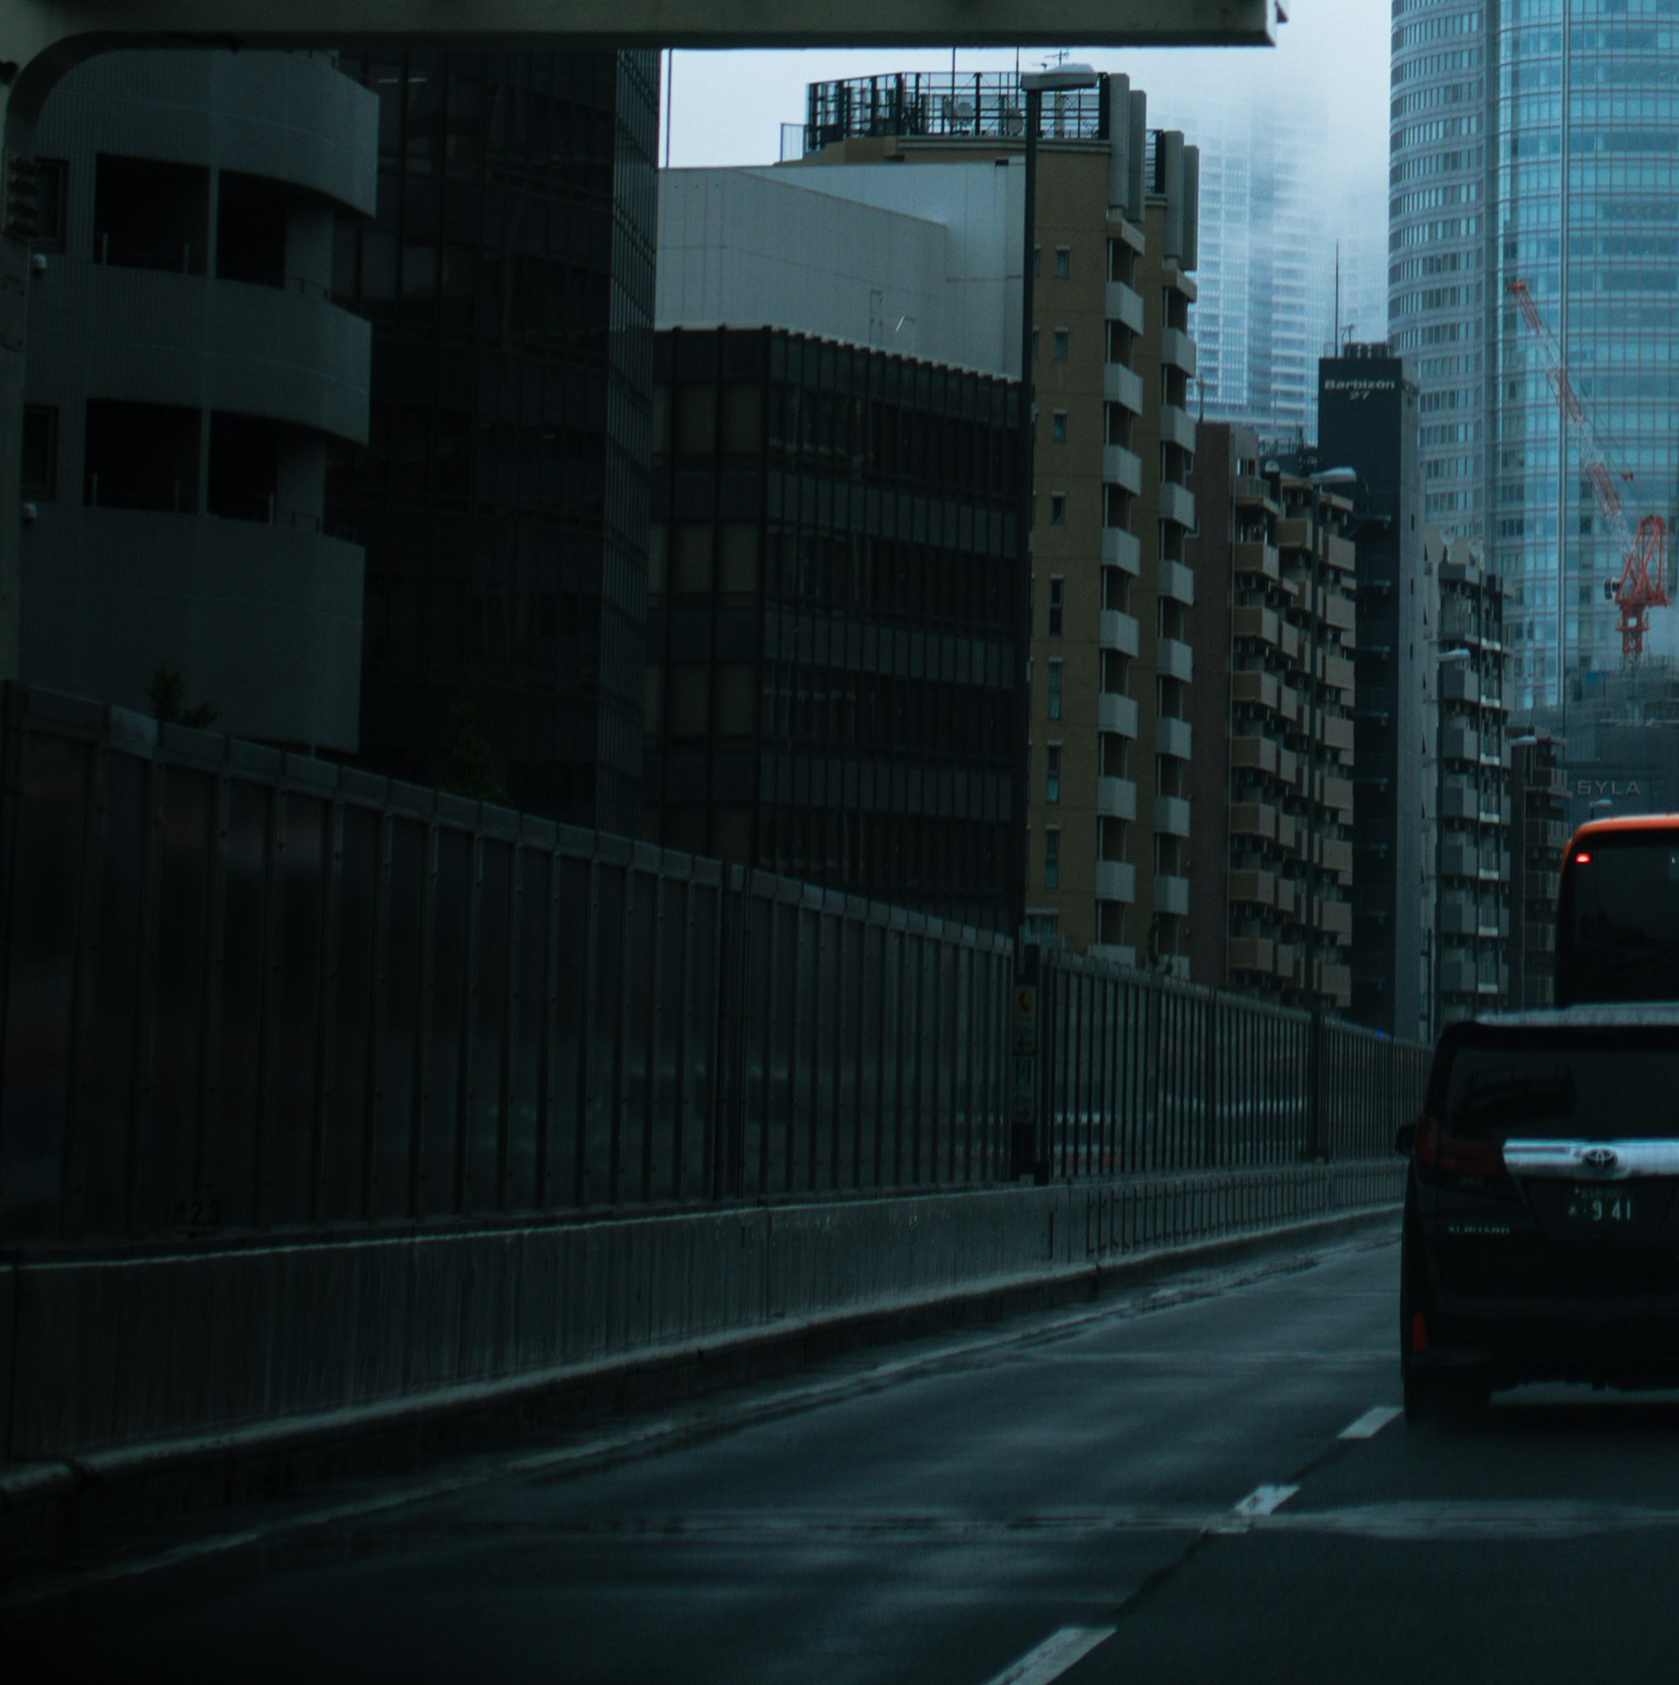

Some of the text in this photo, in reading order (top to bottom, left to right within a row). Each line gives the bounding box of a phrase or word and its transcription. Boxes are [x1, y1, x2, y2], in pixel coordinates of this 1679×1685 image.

[1324, 379, 1395, 390] Barbizon
[1349, 390, 1370, 400] 27
[1577, 780, 1641, 795] SYLA
